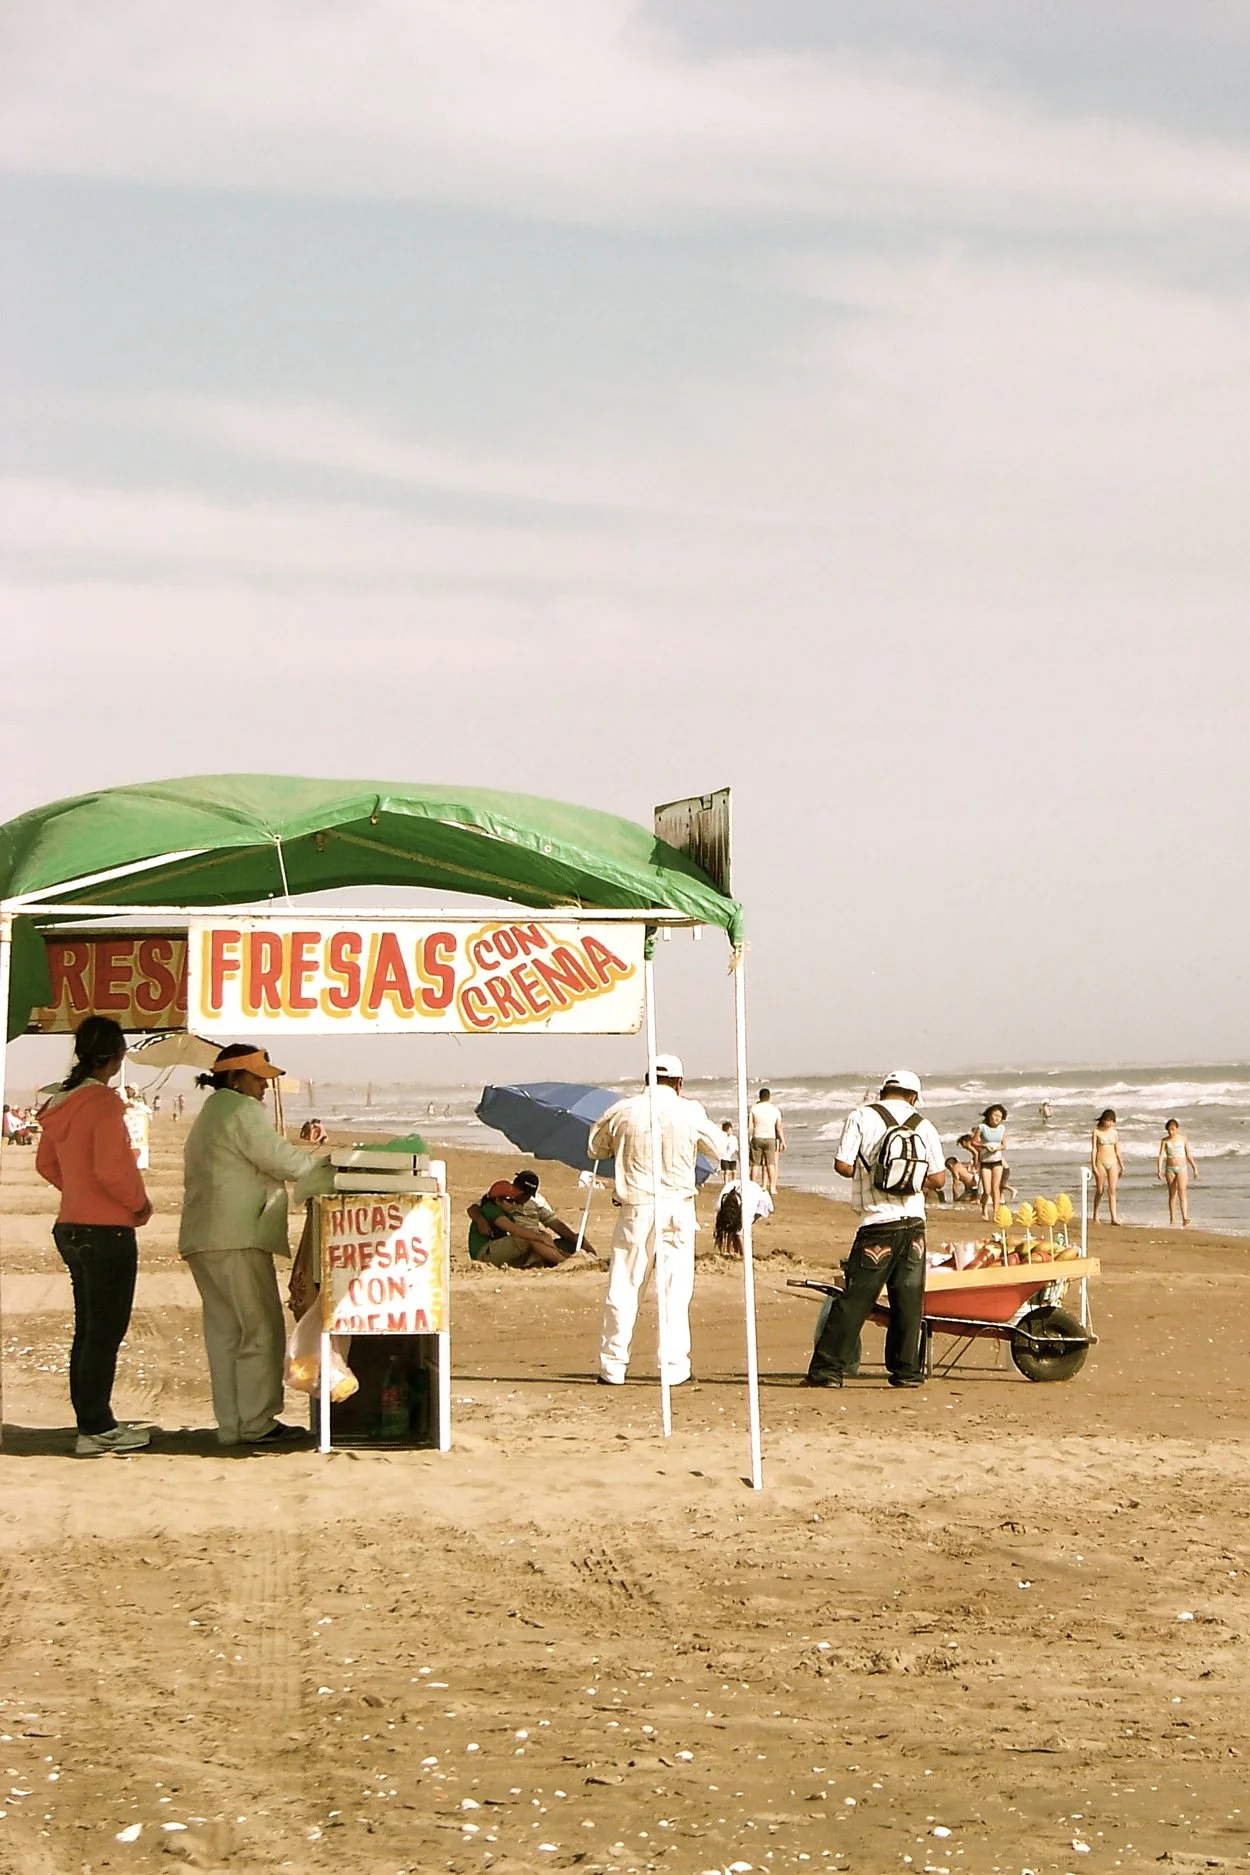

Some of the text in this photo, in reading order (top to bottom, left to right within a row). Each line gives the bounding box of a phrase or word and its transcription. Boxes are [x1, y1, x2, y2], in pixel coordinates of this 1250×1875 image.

[207, 929, 457, 1013] FRESAS
[473, 923, 549, 971] CON
[46, 940, 188, 1011] RES
[461, 935, 628, 1028] CREMA
[331, 1204, 403, 1236] RICAS
[328, 1236, 429, 1271] FRESAS
[348, 1276, 407, 1306] CON
